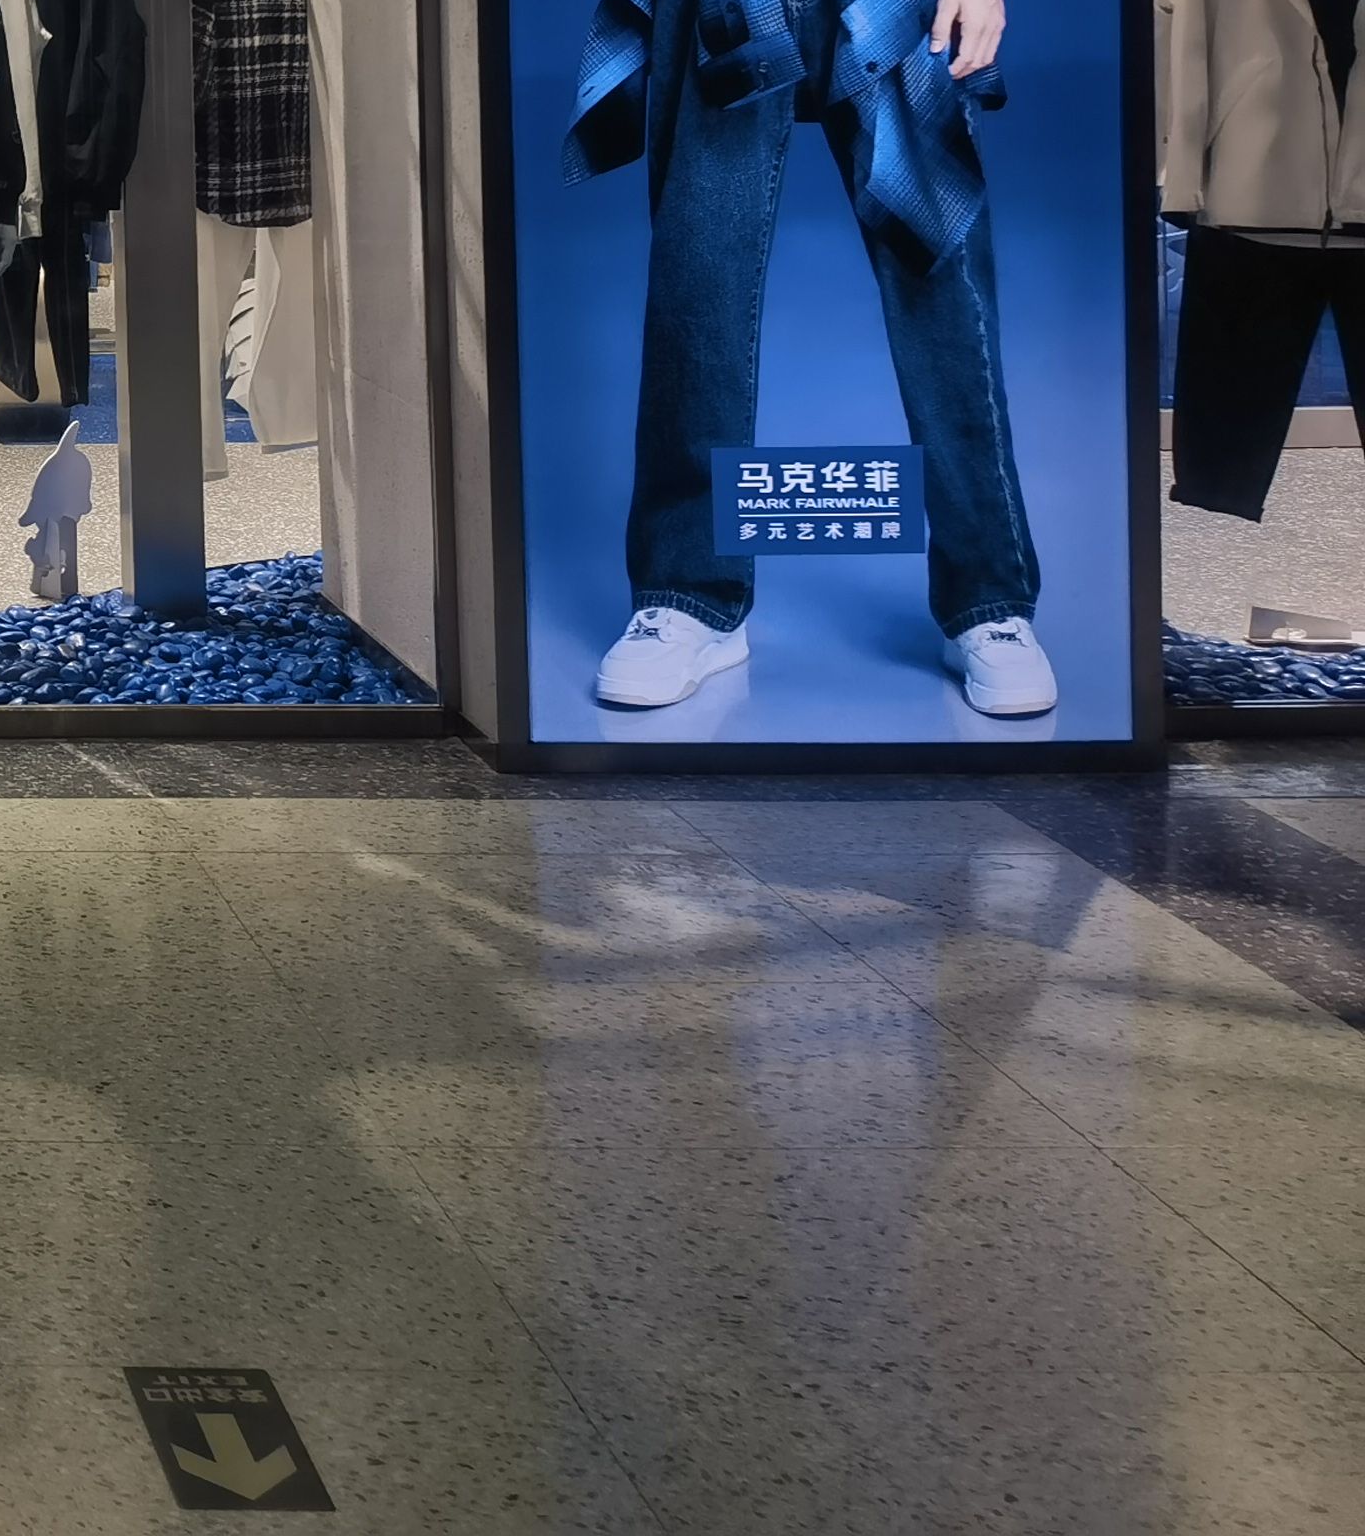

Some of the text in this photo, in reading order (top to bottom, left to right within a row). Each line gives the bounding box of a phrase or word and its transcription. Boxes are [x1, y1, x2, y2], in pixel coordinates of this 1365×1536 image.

[736, 460, 900, 494] 马克华菲
[738, 496, 900, 510] MARK FAIRWHALE
[739, 521, 901, 541] 多元艺术潮牌
[151, 1375, 249, 1386] EXIT
